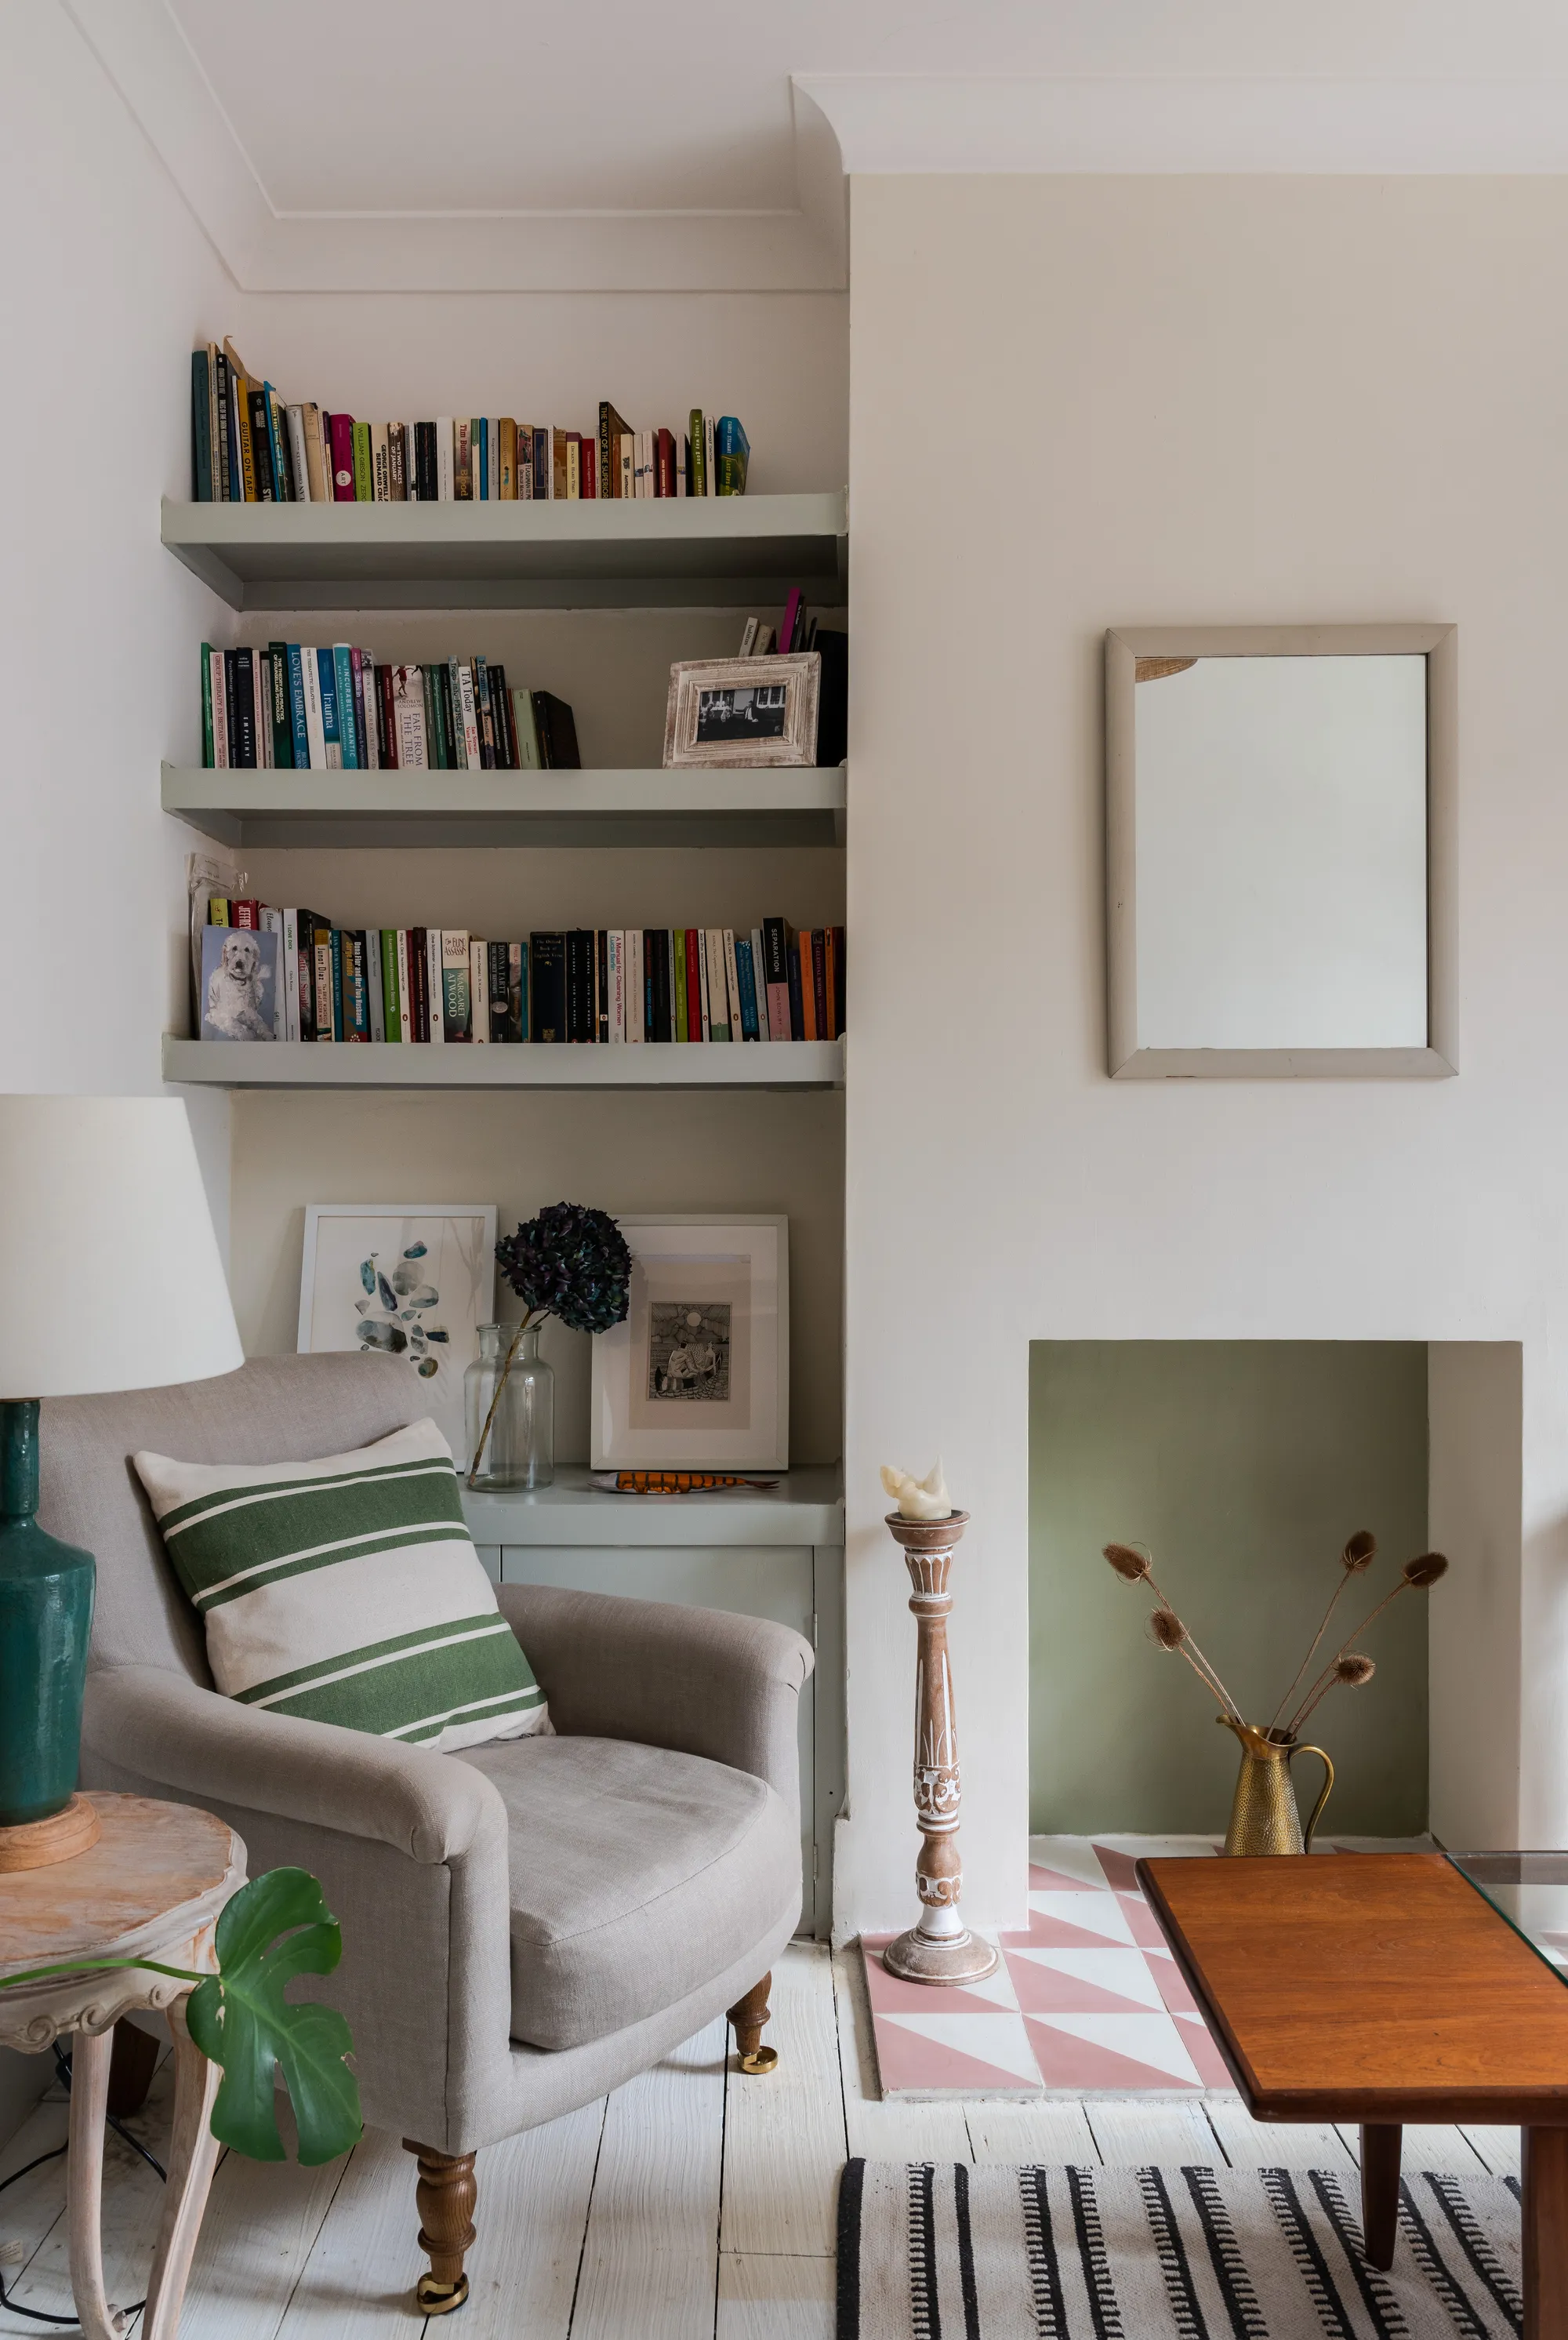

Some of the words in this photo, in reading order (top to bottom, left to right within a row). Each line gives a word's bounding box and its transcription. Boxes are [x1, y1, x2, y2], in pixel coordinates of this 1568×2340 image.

[601, 439, 608, 449] OF
[245, 458, 251, 472] ON
[744, 624, 754, 645] habitus
[291, 652, 301, 686] LOVE'S
[461, 671, 471, 686] TA
[323, 690, 334, 729] Trauma
[463, 688, 473, 713] Today
[294, 690, 306, 739] EMBRACE
[403, 715, 412, 735] THE
[412, 713, 421, 732] FAR
[454, 700, 463, 731] PRINCES
[347, 717, 355, 758] ROMANTIC
[405, 739, 414, 765] TREE
[414, 736, 423, 766] FROM
[345, 941, 353, 958] Jorge
[318, 967, 327, 980] Díaz
[448, 972, 457, 1017] ATWOOD
